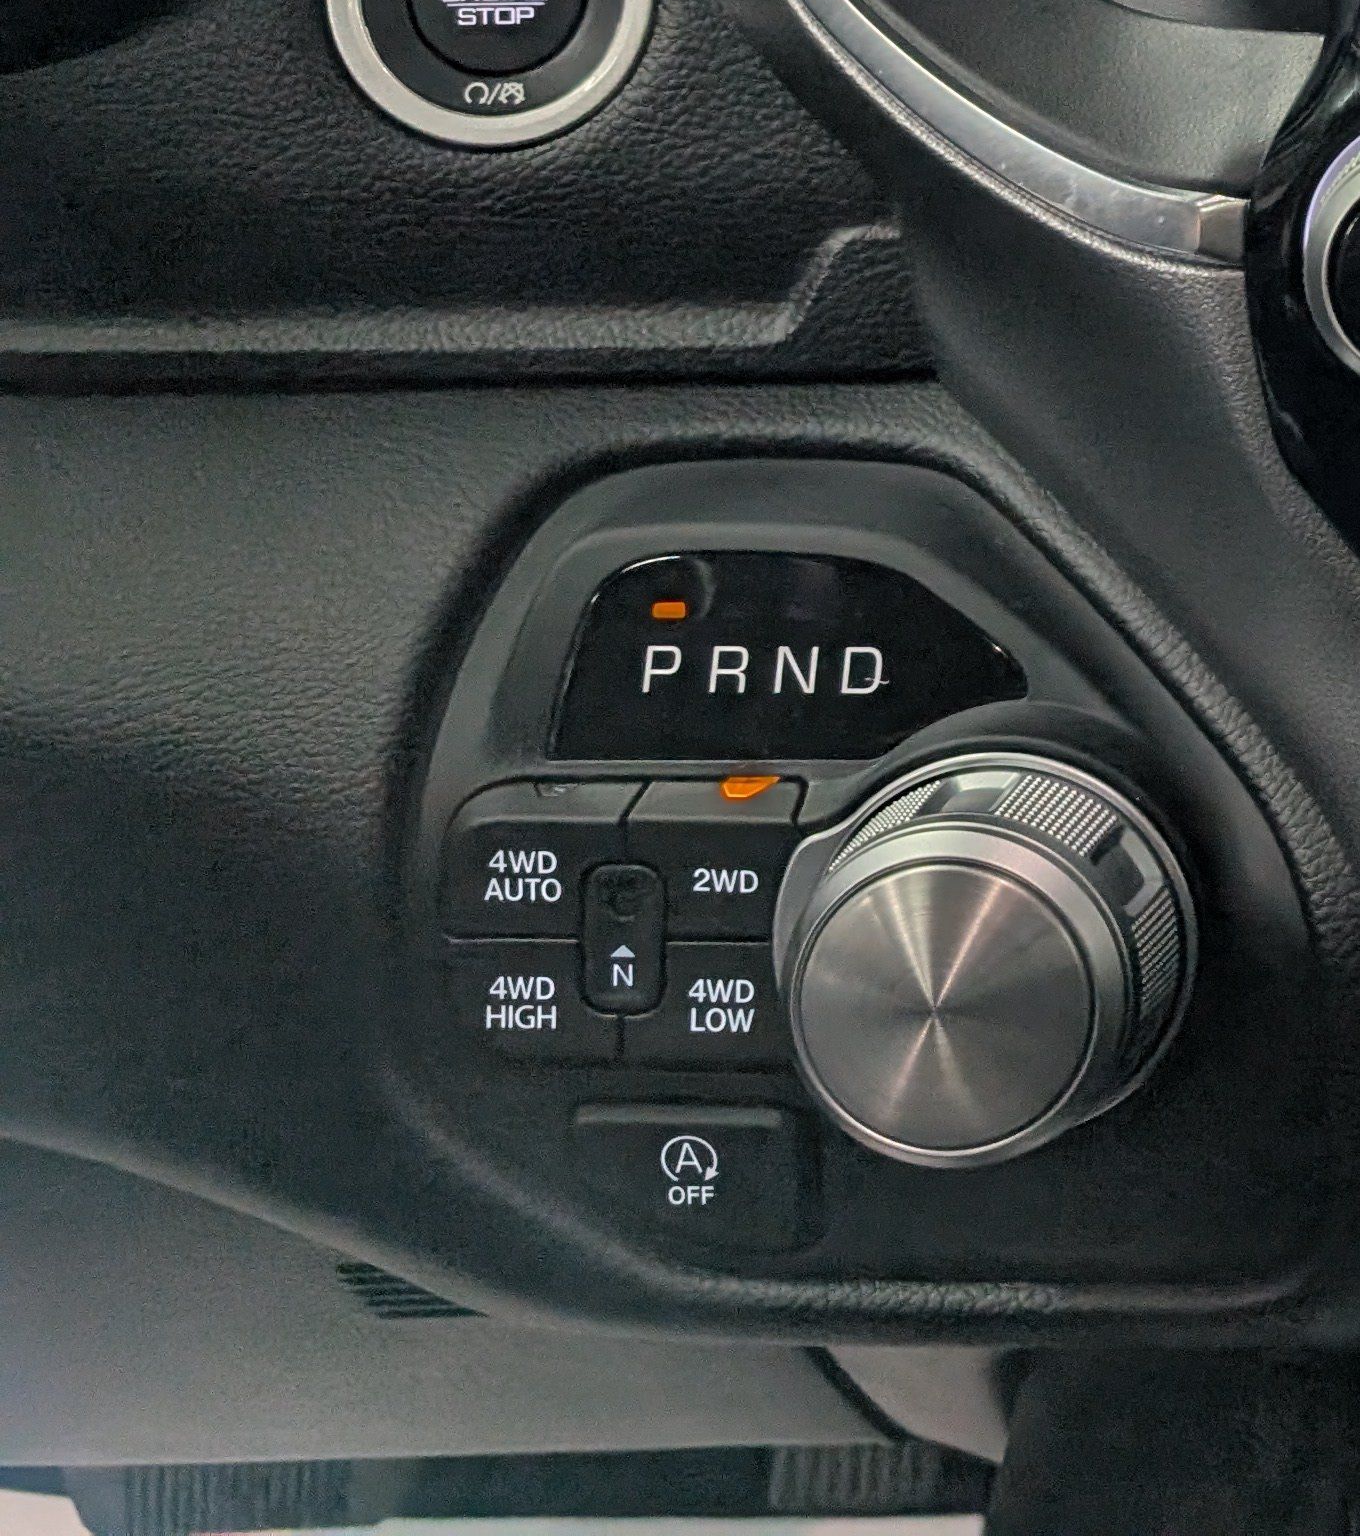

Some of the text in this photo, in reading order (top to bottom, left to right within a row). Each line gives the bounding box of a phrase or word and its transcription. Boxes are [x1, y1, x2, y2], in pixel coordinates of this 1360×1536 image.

[457, 6, 535, 26] STOP
[642, 645, 886, 694] P R N D
[489, 851, 557, 874] 4WD
[484, 878, 562, 902] AUTO
[692, 869, 759, 893] 2WD
[612, 963, 634, 987] N
[489, 976, 555, 1000] 4WD
[688, 979, 755, 1003] 4WD
[485, 1005, 558, 1030] HIGH
[689, 1009, 755, 1033] LOW
[668, 1185, 714, 1206] OFF
